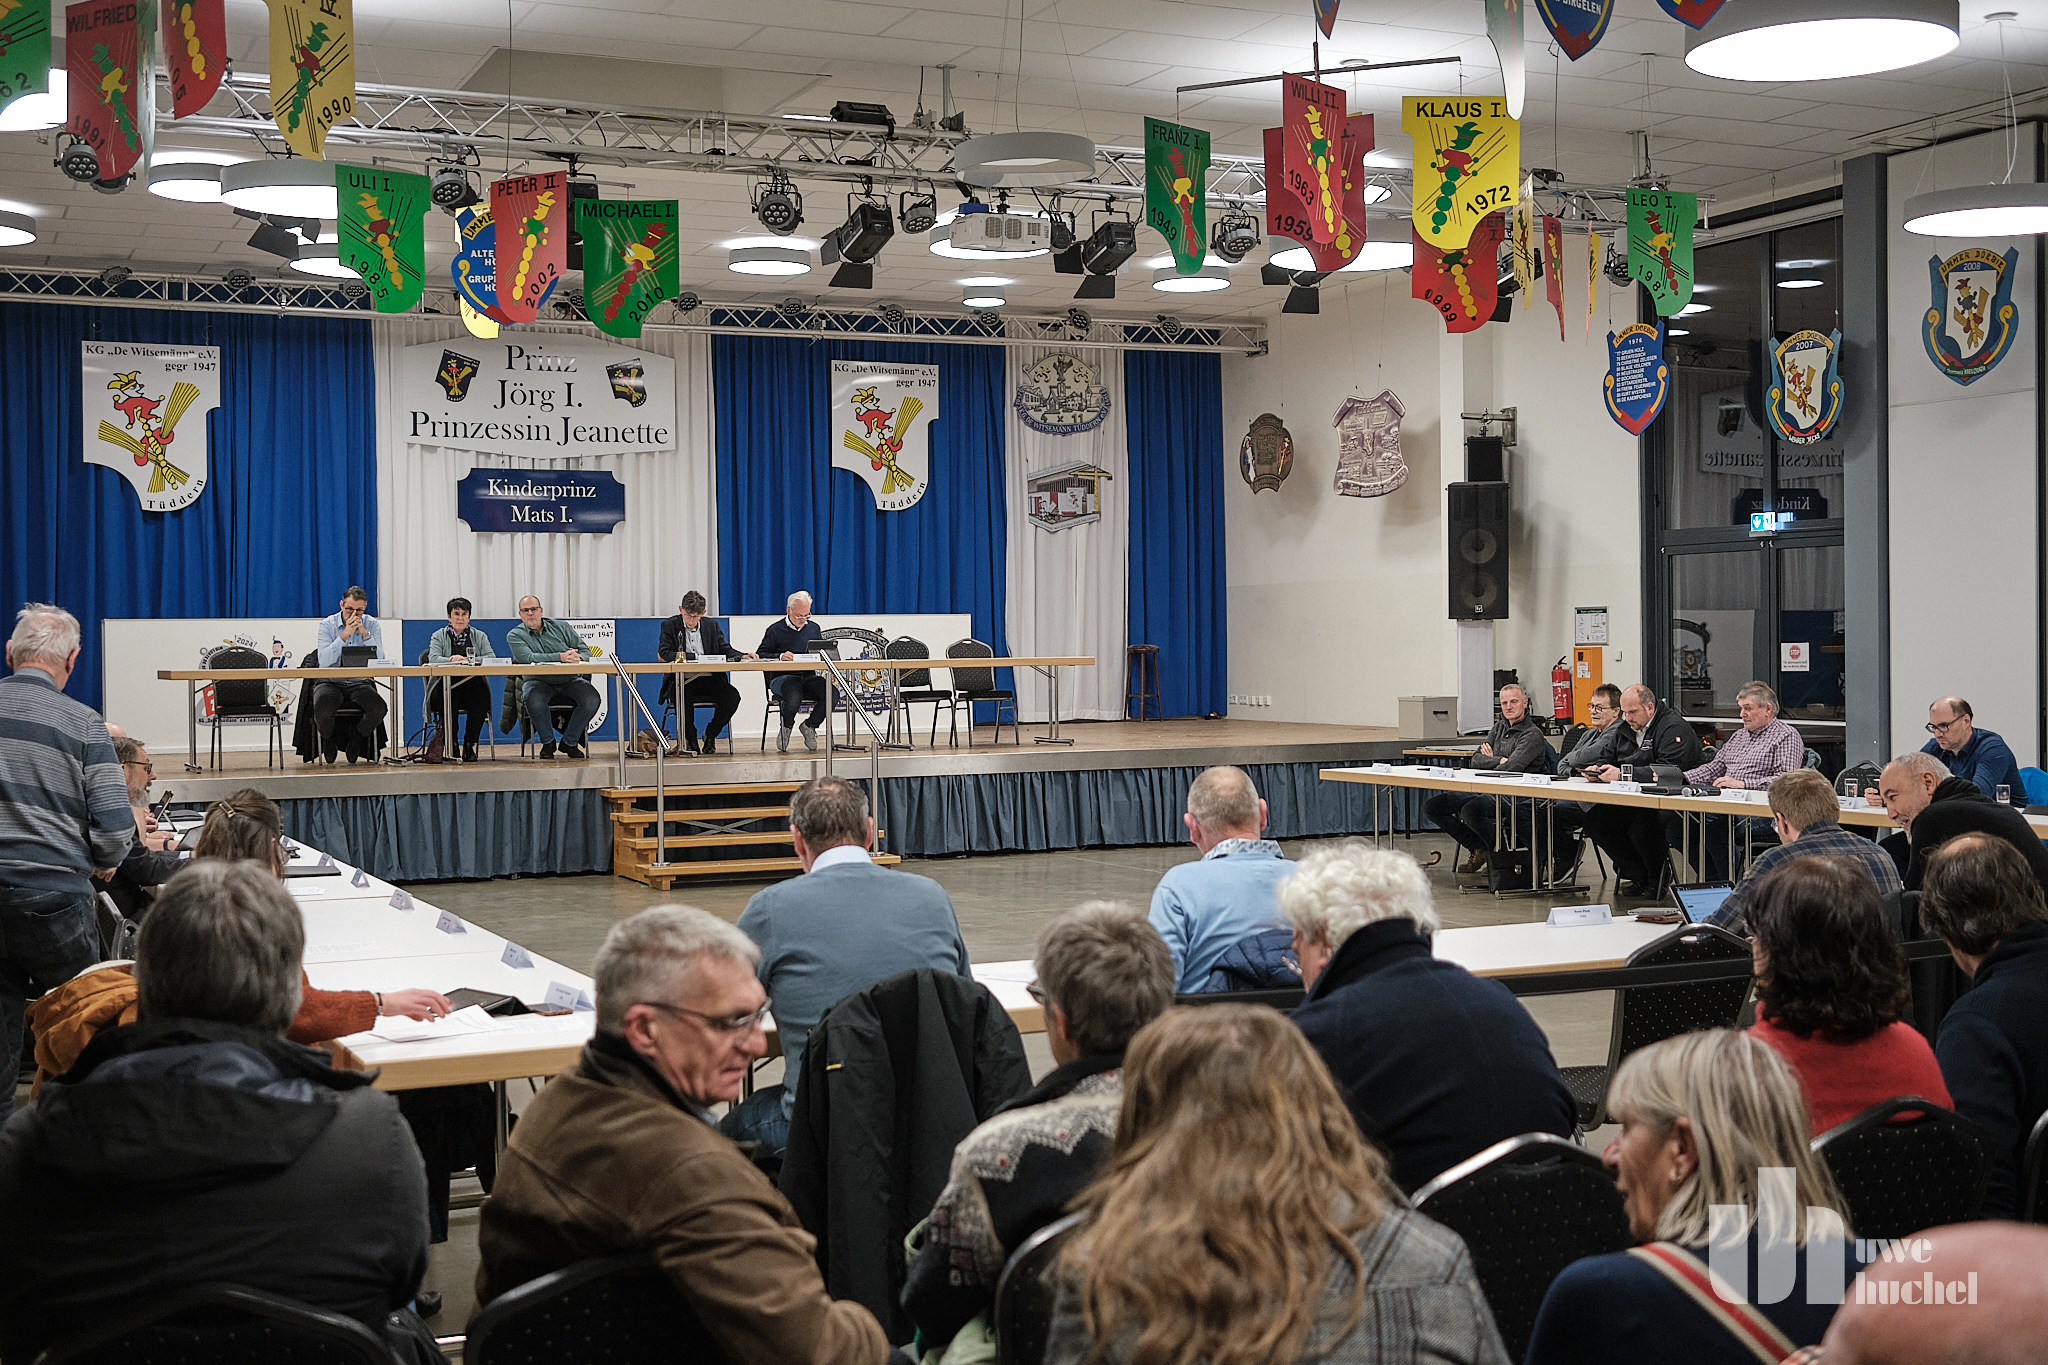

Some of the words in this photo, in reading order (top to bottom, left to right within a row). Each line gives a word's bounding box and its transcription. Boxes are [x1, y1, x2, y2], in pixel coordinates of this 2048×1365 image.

[66, 4, 137, 33] WILFRIED
[1291, 81, 1320, 104] WILLI
[1324, 90, 1340, 110] II.
[317, 96, 351, 131] 1990
[1416, 102, 1482, 118] KLAUS
[1490, 102, 1507, 118] I.
[1152, 125, 1190, 147] FRANZ
[349, 173, 376, 190] ULI
[383, 178, 395, 193] I.
[498, 177, 538, 197] PETER
[543, 174, 560, 190] II.
[1289, 169, 1315, 206] 1963
[582, 203, 662, 218] MICHAEL
[665, 204, 675, 218] I.
[1465, 185, 1512, 216] 1972
[1632, 194, 1659, 207] LEO
[1665, 196, 1677, 209] I.
[1150, 206, 1178, 241] 1949
[349, 253, 390, 299] 1985
[1963, 262, 1981, 271] 2008
[525, 262, 557, 309] 2002
[1638, 264, 1666, 300] 1981
[628, 286, 665, 323] 2010
[85, 345, 104, 355] KG
[198, 351, 216, 359] e.V.
[1628, 337, 1643, 345] 1976
[1795, 341, 1813, 350] 2007
[165, 363, 188, 372] gegr
[193, 362, 216, 372] 1947
[505, 345, 578, 373] Prinz
[834, 364, 849, 373] KG
[922, 369, 936, 377] e.V.
[896, 380, 914, 388] gegr
[918, 379, 936, 387] 1947
[493, 379, 555, 412] Jörg
[563, 382, 583, 408] I.
[410, 411, 551, 442] Prinzessin
[557, 416, 668, 446] Jeanette
[1041, 412, 1049, 424] 4
[1071, 412, 1084, 424] 11
[147, 479, 204, 509] Tüddern
[487, 478, 596, 502] Kinderprinz
[881, 482, 925, 509] Tüddern
[511, 506, 554, 523] Mats
[560, 506, 573, 523] I.
[236, 637, 253, 647] 2024
